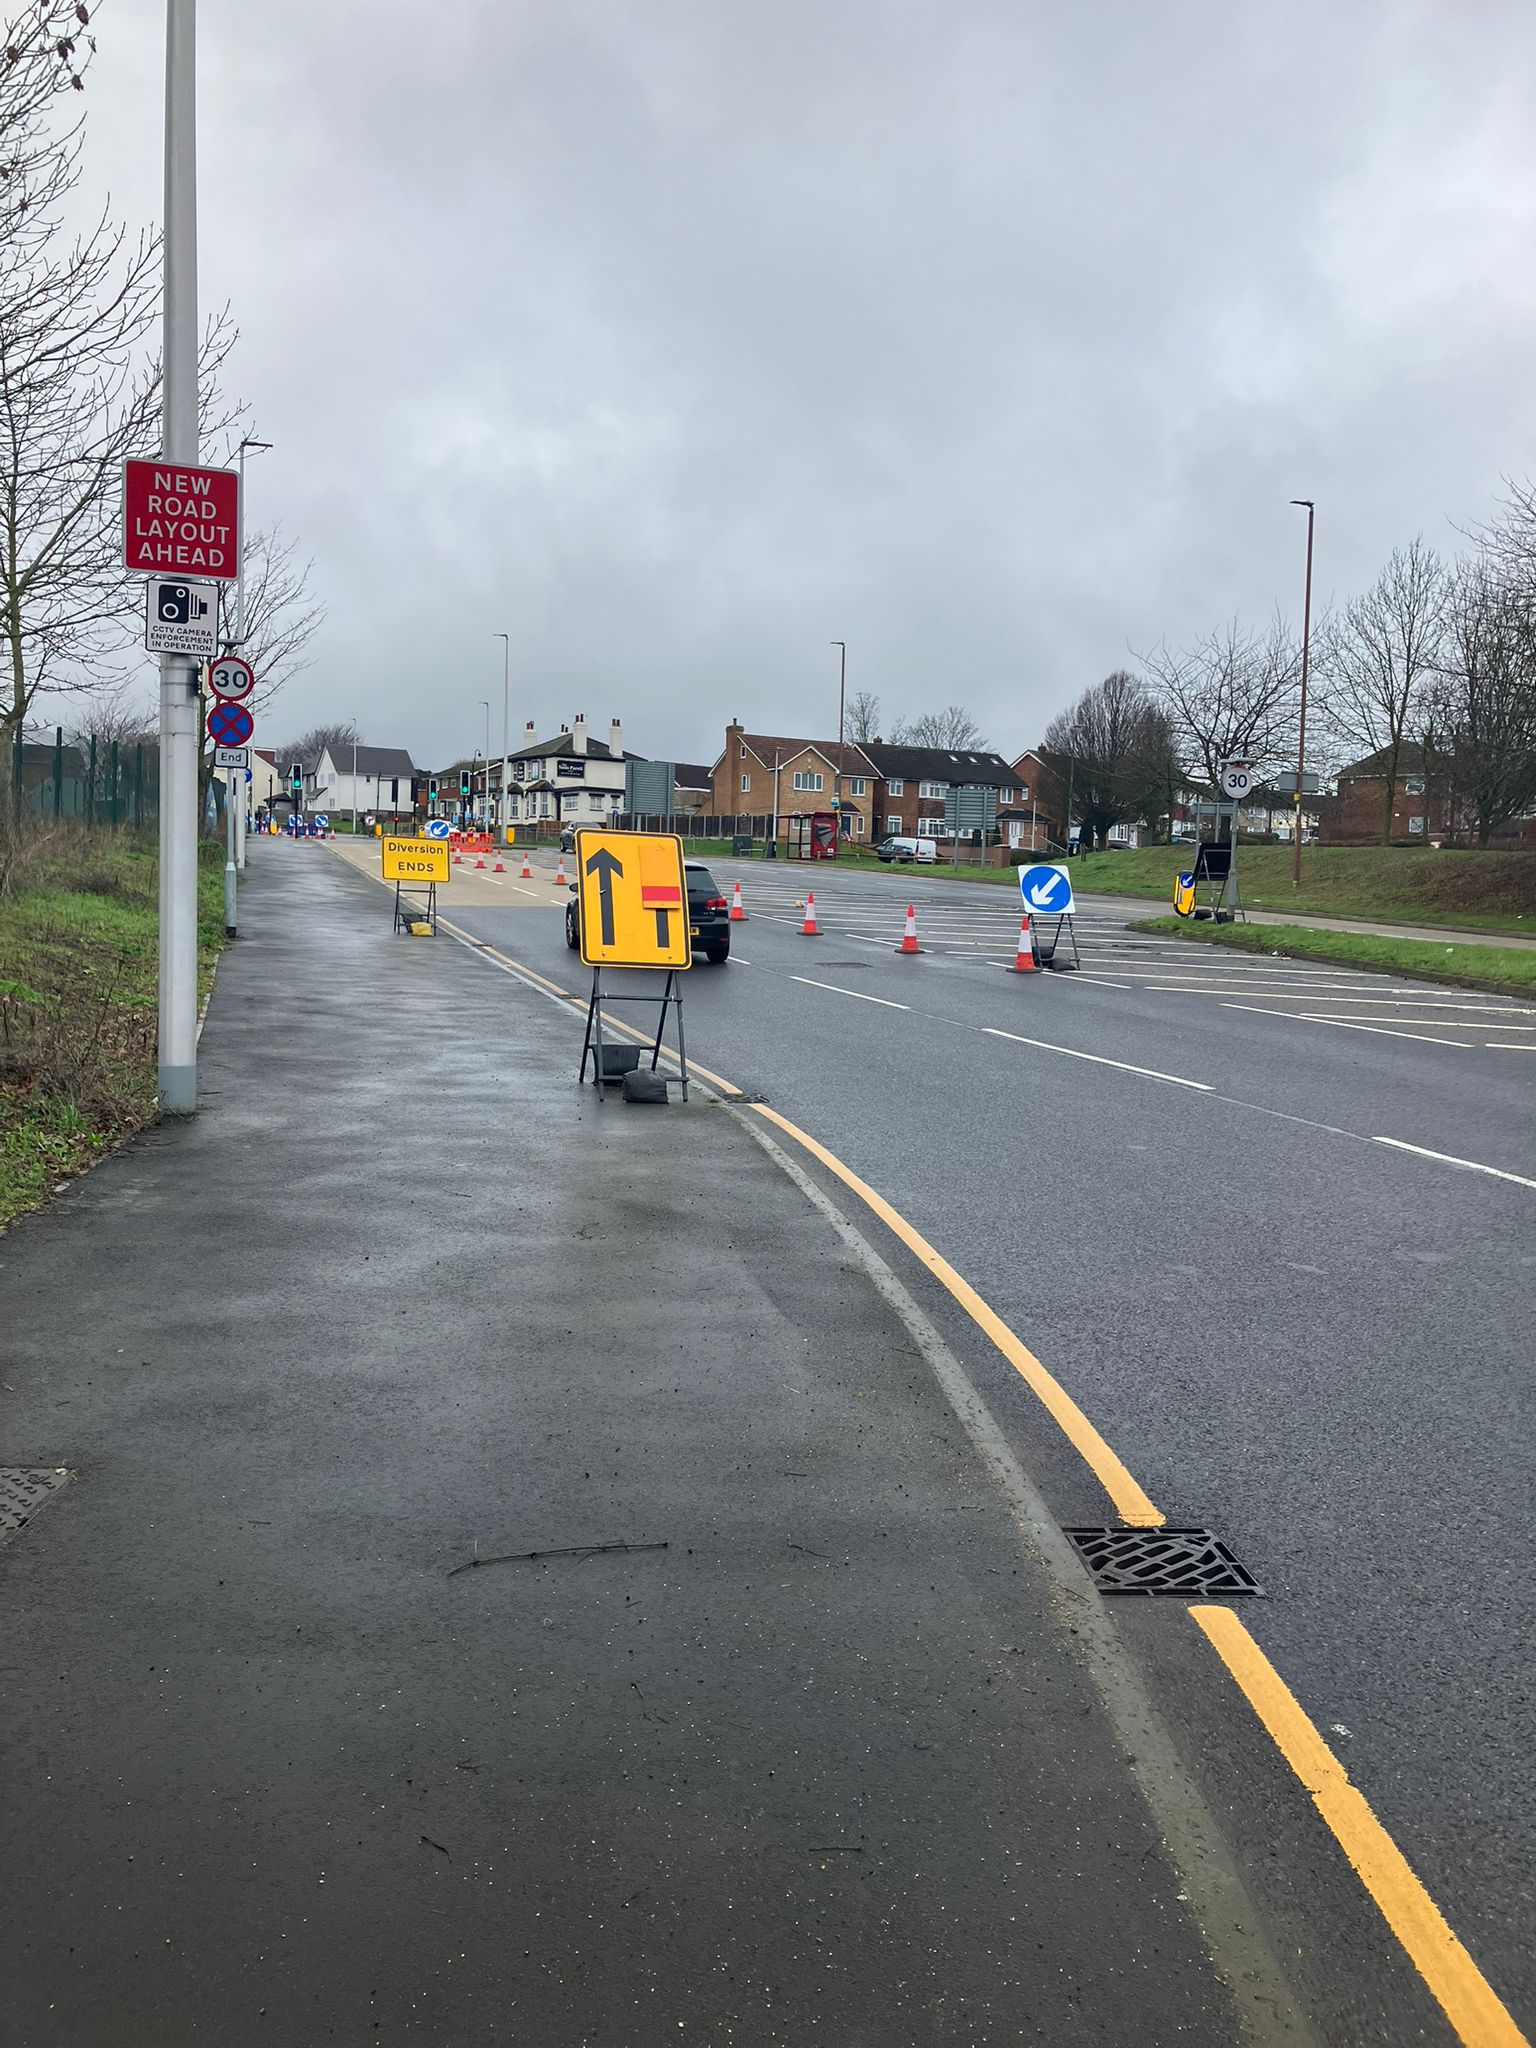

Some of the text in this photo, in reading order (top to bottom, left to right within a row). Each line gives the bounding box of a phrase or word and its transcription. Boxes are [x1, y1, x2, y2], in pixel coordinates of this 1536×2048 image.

[154, 472, 211, 496] NEW
[148, 495, 217, 520] ROAD
[136, 518, 230, 545] LAYOUT
[138, 542, 225, 568] AHEAD
[152, 625, 212, 637] CCTV CAMERA
[150, 632, 214, 645] ENFORCEMENT
[164, 641, 212, 652] OPERATION
[215, 669, 248, 689] 30
[221, 752, 242, 762] End
[1228, 773, 1248, 788] 30
[388, 842, 444, 855] Diversion
[398, 861, 434, 872] ENDS
